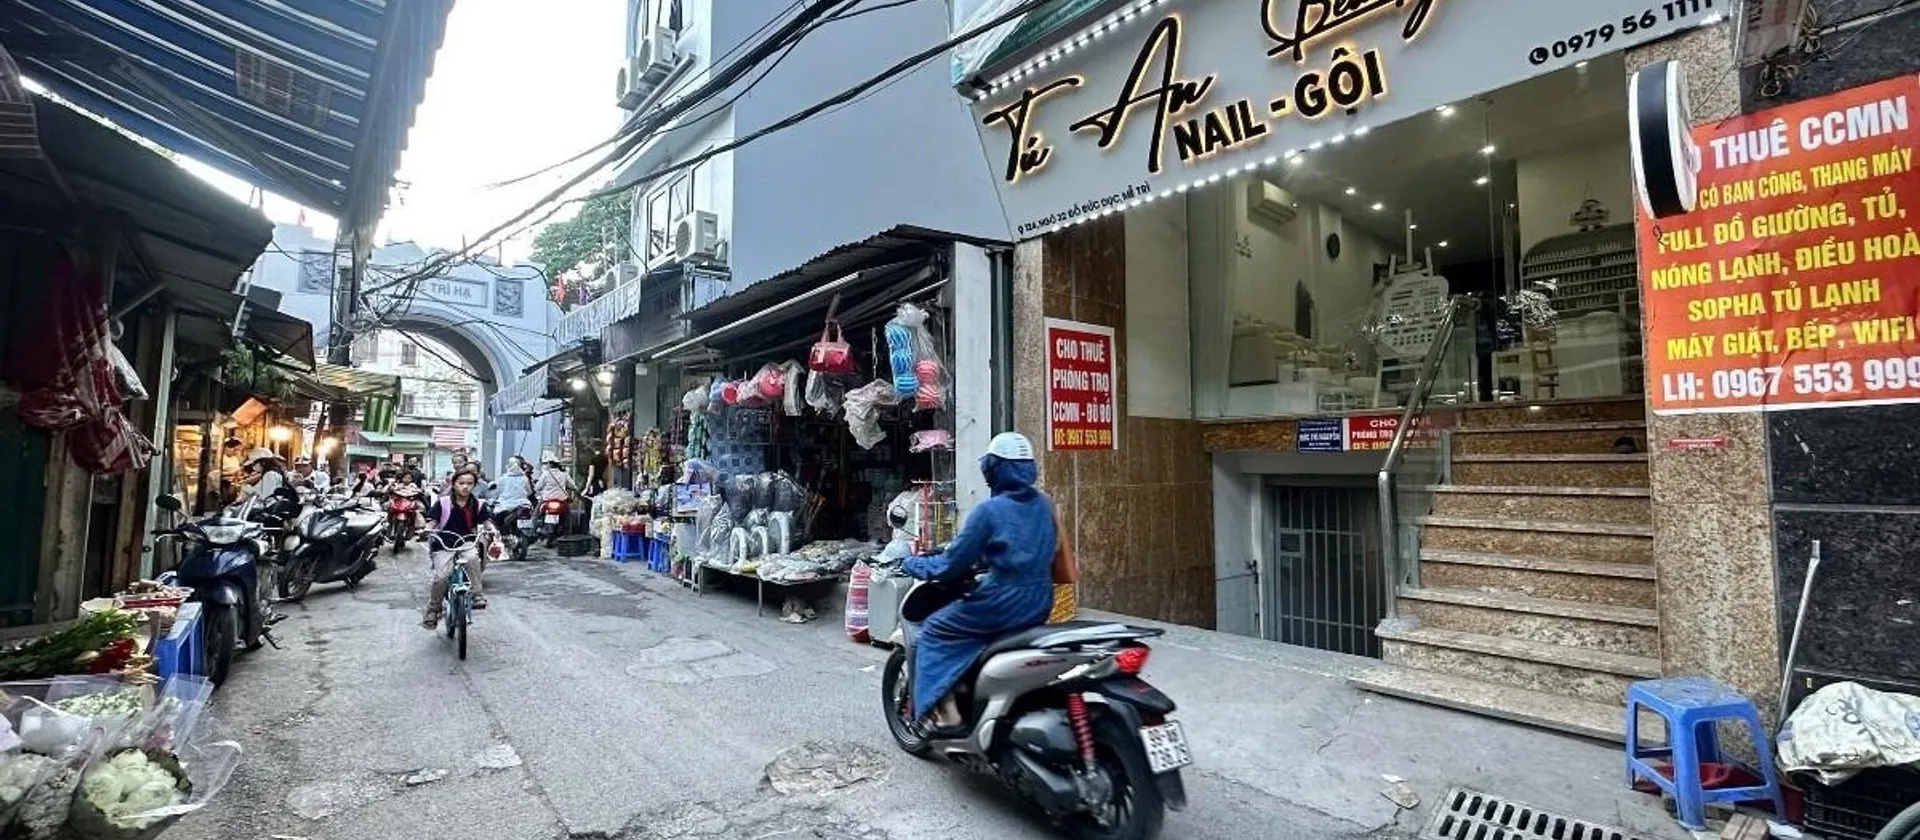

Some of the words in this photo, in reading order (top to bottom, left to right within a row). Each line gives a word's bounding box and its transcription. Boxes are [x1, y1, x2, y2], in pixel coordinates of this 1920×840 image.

[1552, 24, 1615, 58] 0979
[1622, 9, 1657, 34] 56
[1173, 100, 1267, 161] NAIL
[1295, 47, 1384, 117] GỘI
[1709, 117, 1790, 169] THUÊ
[1800, 96, 1909, 150] CCMN
[1699, 182, 1720, 210] CÓ
[1723, 180, 1755, 205] BAN
[1759, 170, 1807, 198] CÔNG,
[1810, 157, 1869, 189] THANG
[1872, 145, 1912, 177] MÁY
[1659, 227, 1708, 254] FULL
[1714, 212, 1745, 245] ĐỒ
[1752, 202, 1856, 239] GIƯỜNG,
[1862, 186, 1906, 221] TỦ,
[1651, 262, 1713, 290] NÓNG
[1718, 251, 1788, 283] LẠNH,
[1795, 235, 1856, 271] ĐIỀU
[1688, 292, 1766, 322] SOPHA
[1771, 281, 1802, 312] TỦ
[1809, 278, 1881, 311] LẠNH
[1055, 338, 1078, 360] CHO
[1080, 339, 1105, 362] THUÊ
[1667, 332, 1716, 361] MÁY
[1852, 316, 1915, 345] WIFI
[1053, 364, 1089, 391] PHÒNG
[1662, 372, 1705, 402] LH:
[1712, 365, 1784, 398] 0967
[1793, 361, 1853, 394] 553
[1863, 356, 1920, 391] 999
[1053, 400, 1080, 423] CCMN
[1370, 418, 1398, 428] CHO
